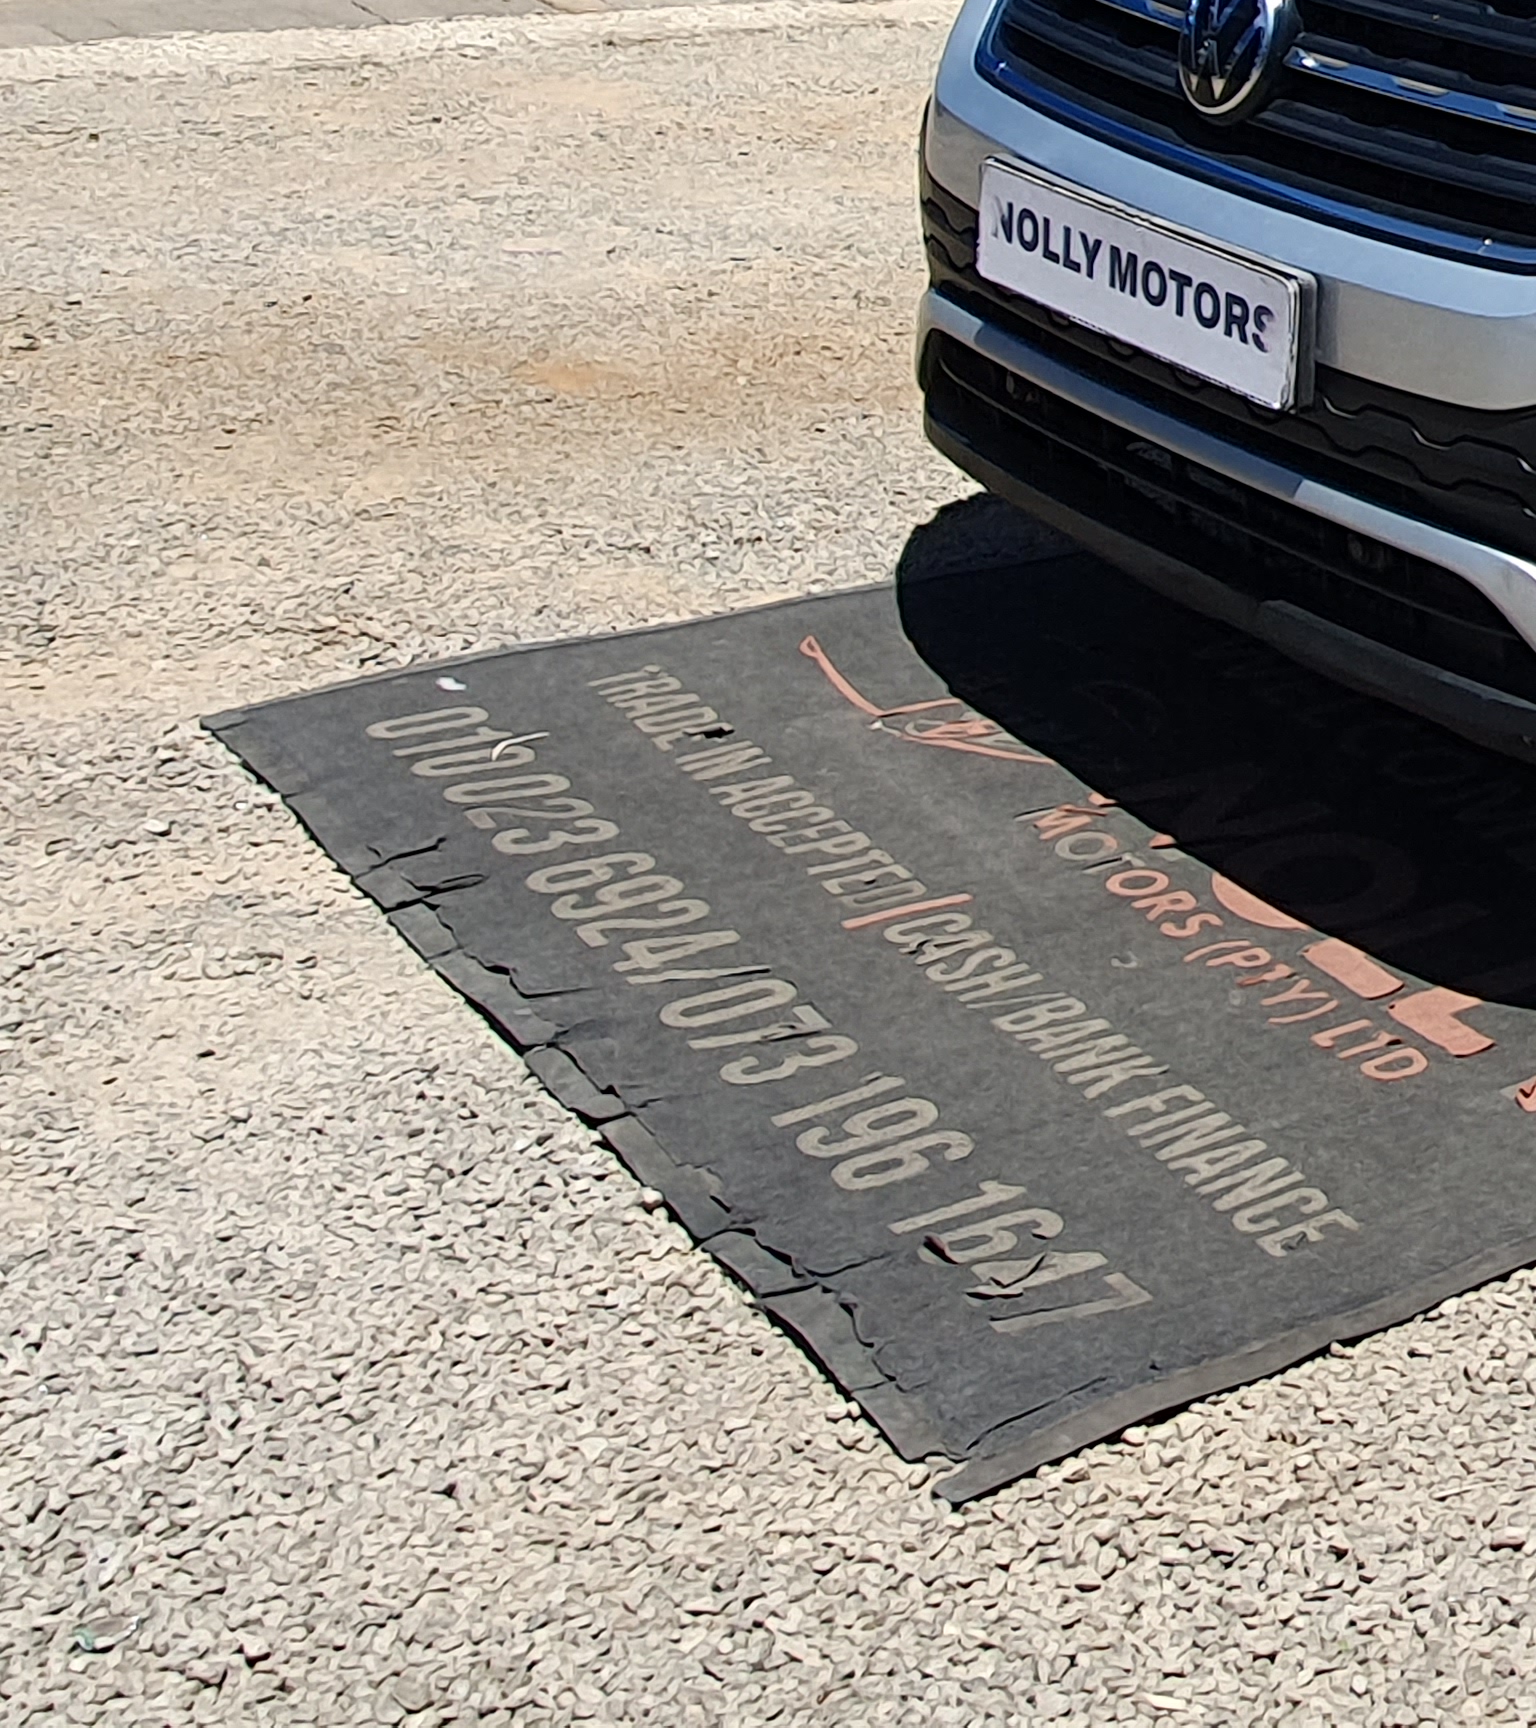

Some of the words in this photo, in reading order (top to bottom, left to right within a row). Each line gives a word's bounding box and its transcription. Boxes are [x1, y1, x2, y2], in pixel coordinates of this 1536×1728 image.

[990, 196, 1102, 280] NOLLY
[1108, 244, 1275, 354] MOTORS
[588, 664, 735, 752] TRADE
[674, 740, 772, 780] IN
[1103, 1084, 1360, 1258] FINANCE
[1183, 939, 1341, 1026] (PTY)
[1310, 1017, 1430, 1083] LTD
[770, 1071, 976, 1191] 196
